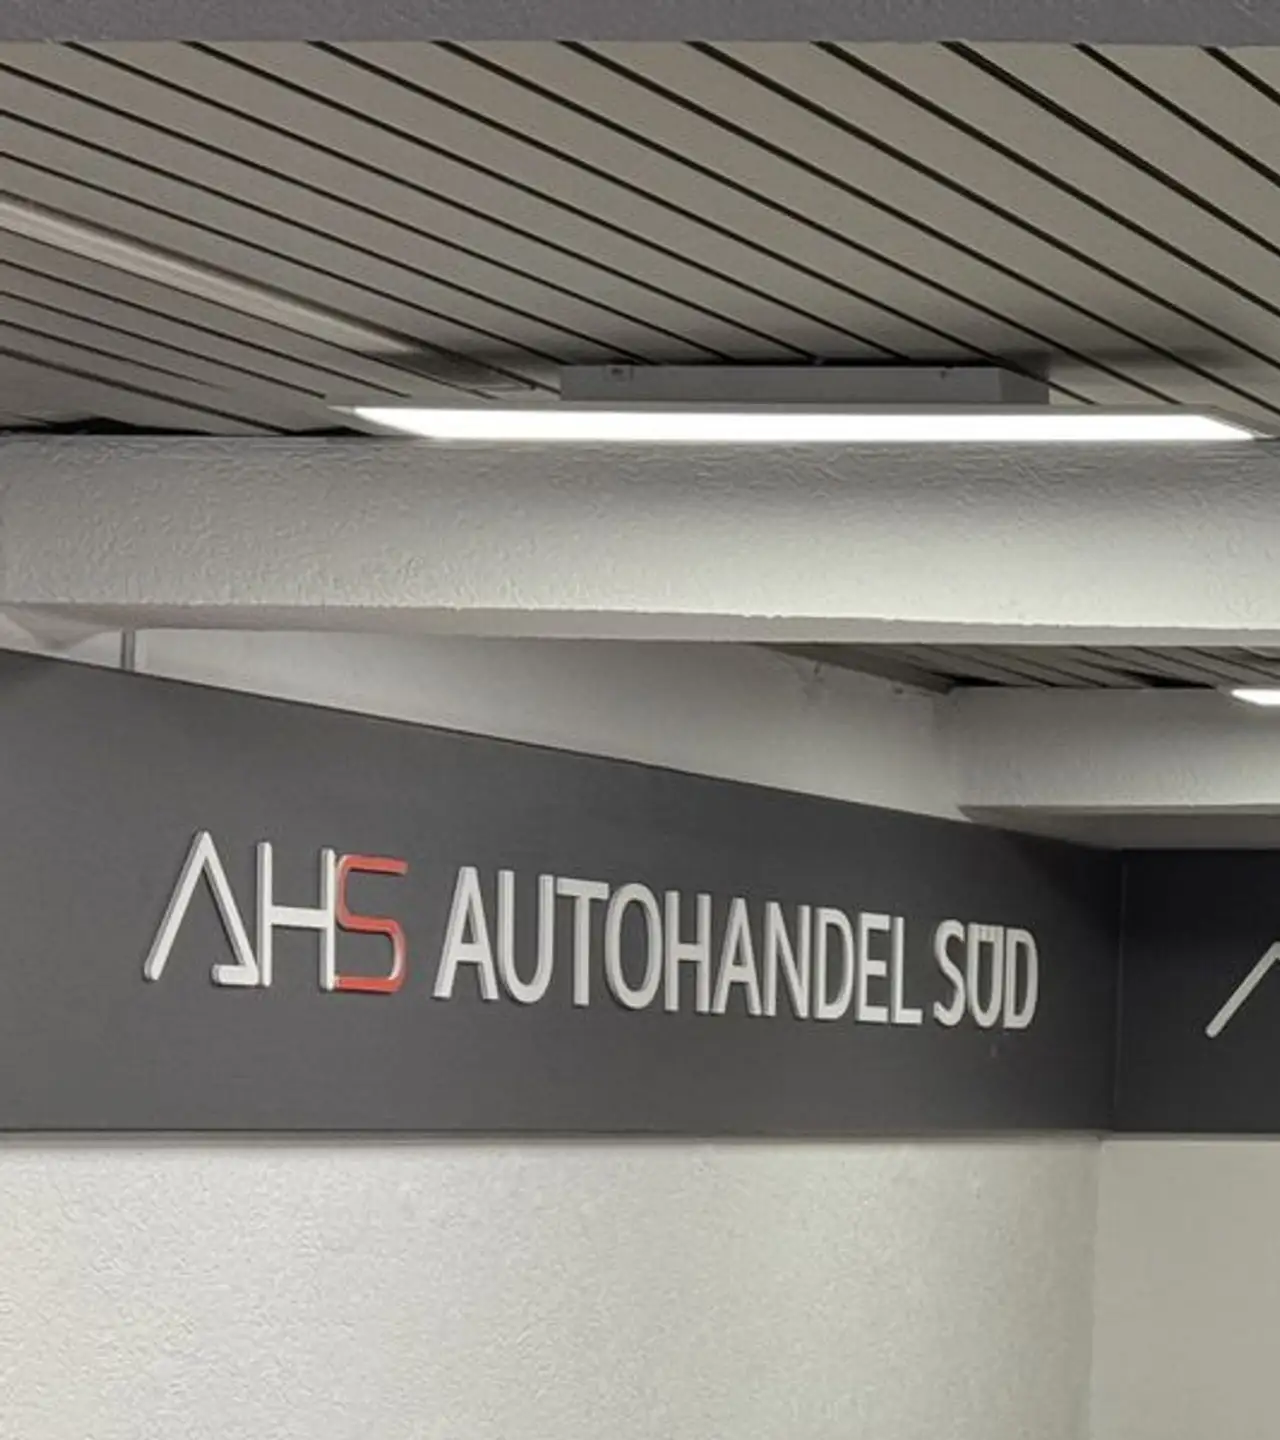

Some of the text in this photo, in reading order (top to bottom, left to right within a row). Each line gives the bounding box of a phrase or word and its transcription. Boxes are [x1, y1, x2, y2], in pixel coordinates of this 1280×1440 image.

[144, 831, 1039, 1030] AHS AUTOHANDEL SÜD
